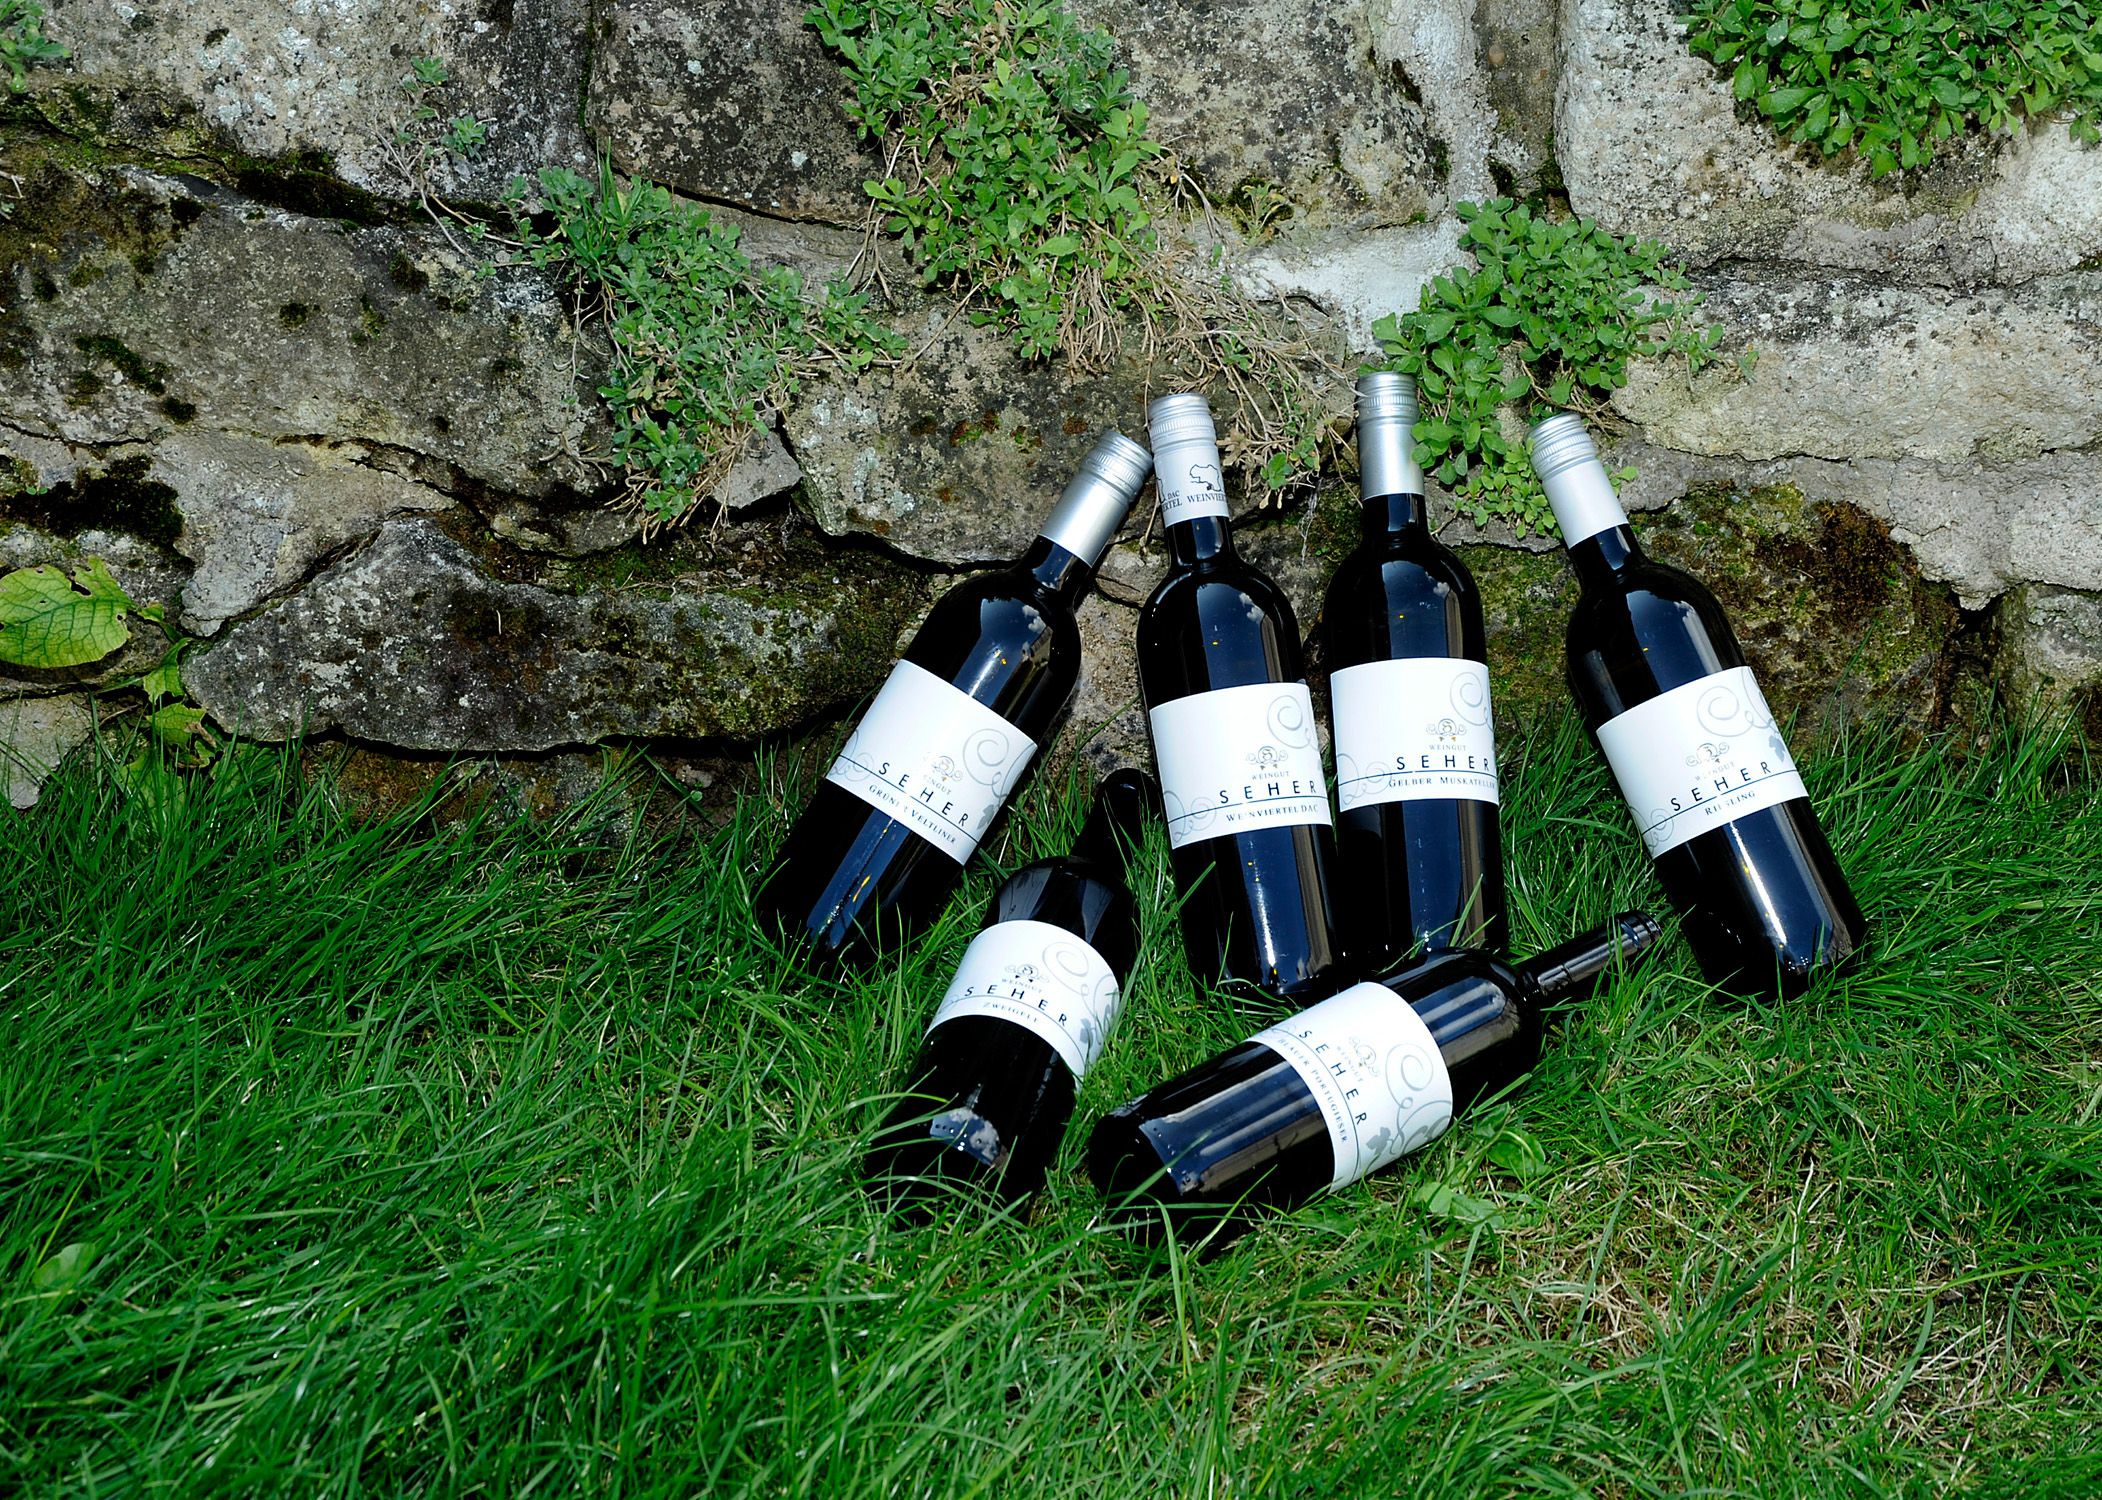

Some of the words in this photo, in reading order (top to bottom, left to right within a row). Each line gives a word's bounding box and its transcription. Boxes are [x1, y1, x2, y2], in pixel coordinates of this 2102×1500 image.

[1167, 490, 1180, 500] DAC
[1251, 770, 1290, 780] WEINGUT
[1396, 754, 1490, 772] SEHER
[878, 762, 970, 827] SEHER
[1219, 780, 1317, 804] SEHER
[1388, 777, 1432, 788] GELBER
[1670, 761, 1771, 812] SEHER
[1226, 805, 1298, 822] WENVIERTEL
[1300, 804, 1319, 813] DAC
[911, 809, 956, 844] VELTLINER
[964, 984, 1067, 1027] SEHER
[1298, 1030, 1368, 1126] SEHER
